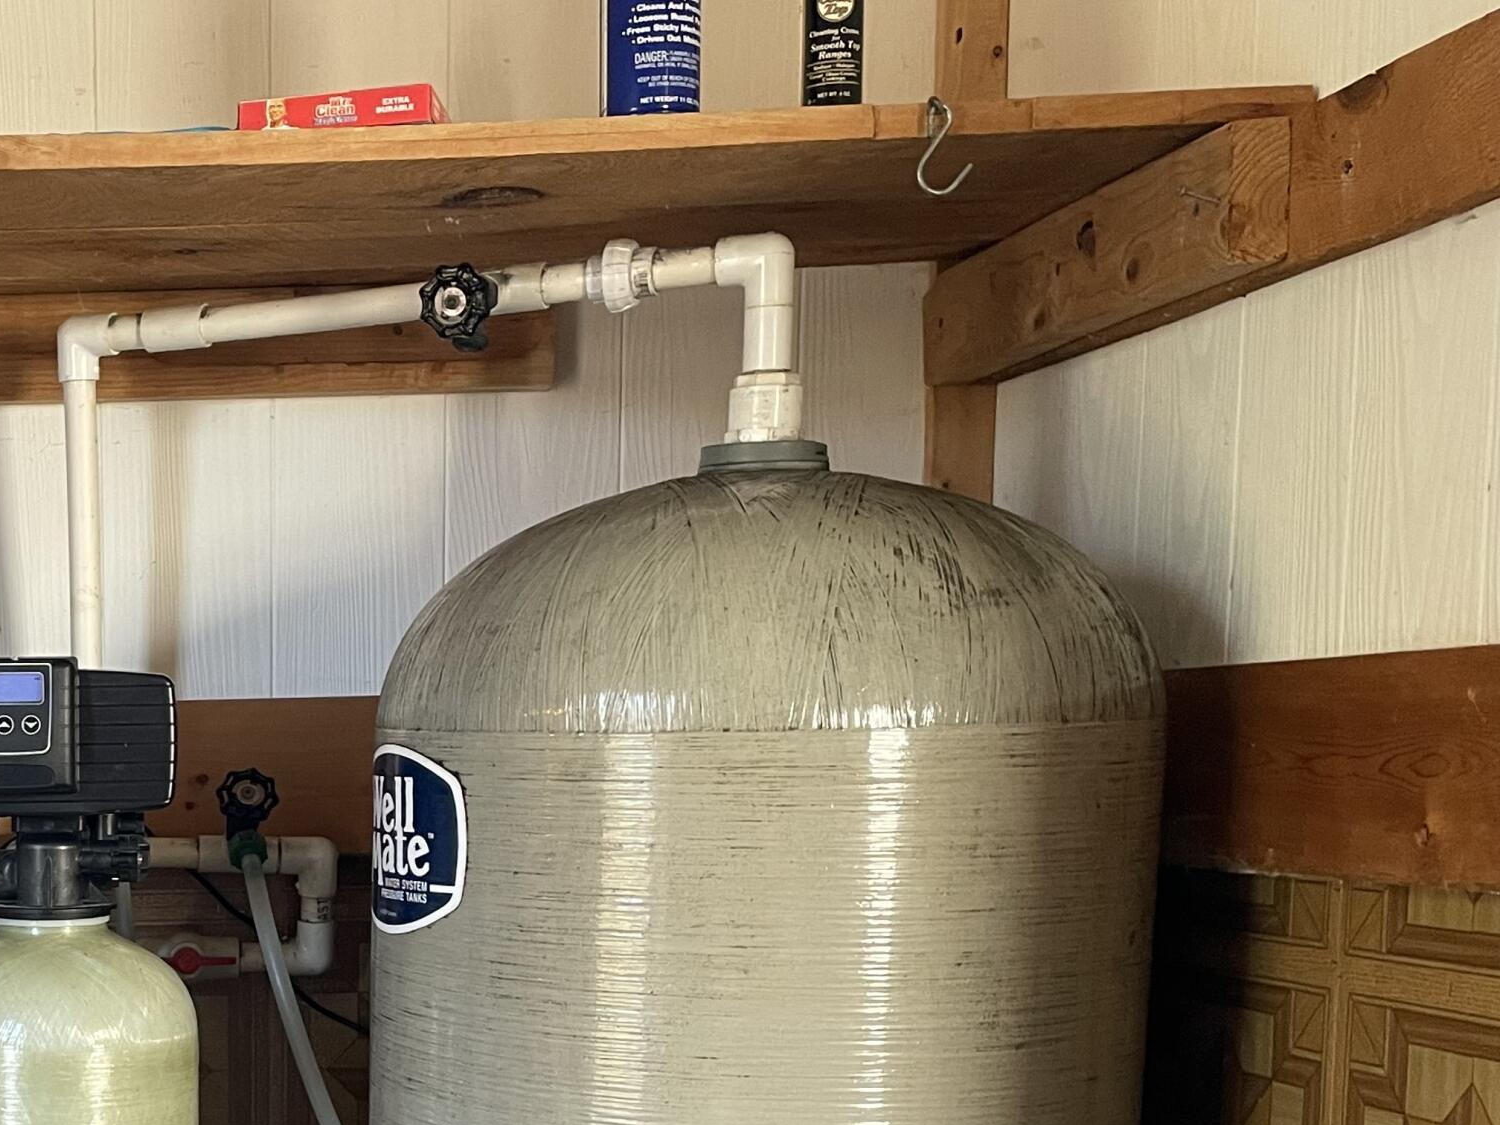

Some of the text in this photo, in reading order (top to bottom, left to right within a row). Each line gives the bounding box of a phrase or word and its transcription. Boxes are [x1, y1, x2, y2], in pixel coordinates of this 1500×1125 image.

[810, 40, 861, 52] Smooth Top
[818, 51, 852, 60] Ranges
[382, 95, 410, 106] EXTRA
[315, 104, 356, 118] Clean
[375, 103, 415, 114] DURABLE
[401, 878, 428, 892] SYSTEM
[405, 891, 428, 904] TANKS
